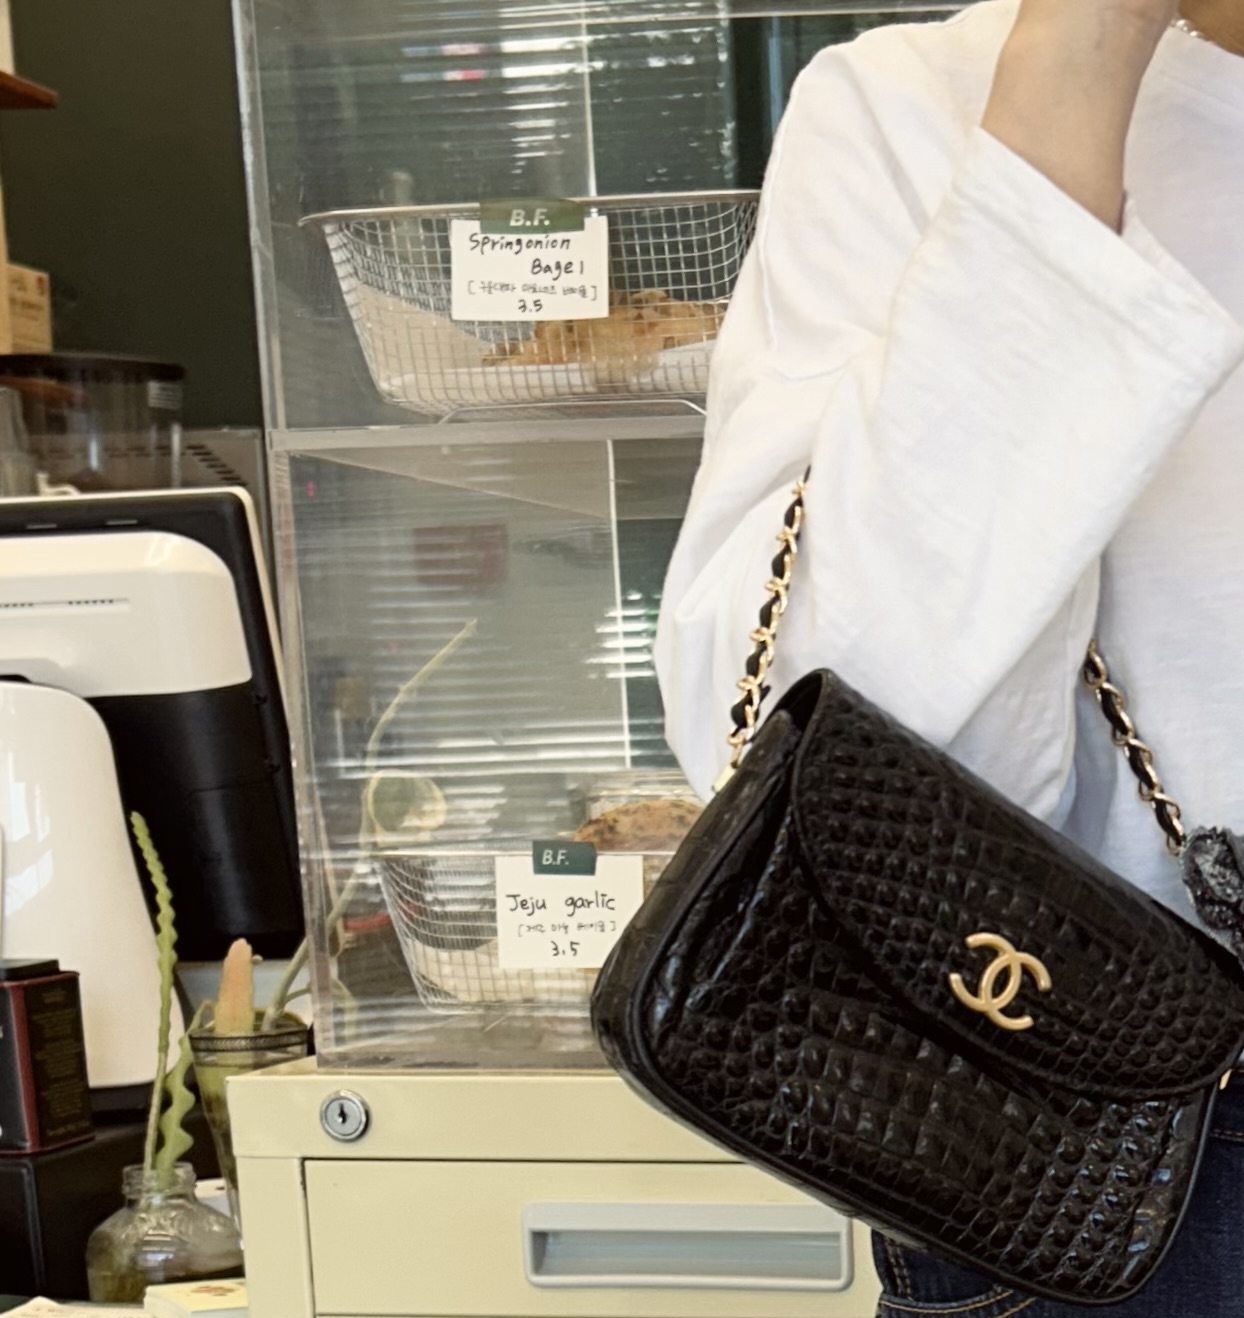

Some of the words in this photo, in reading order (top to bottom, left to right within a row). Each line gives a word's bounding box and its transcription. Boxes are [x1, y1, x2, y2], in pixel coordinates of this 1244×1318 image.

[509, 208, 550, 227] B.F.
[530, 257, 584, 281] Bagel
[517, 299, 544, 313] 3.5
[541, 849, 570, 866] B.F.
[505, 893, 547, 917] Jeju
[564, 890, 616, 918] garlic
[550, 940, 581, 957] 3.5
